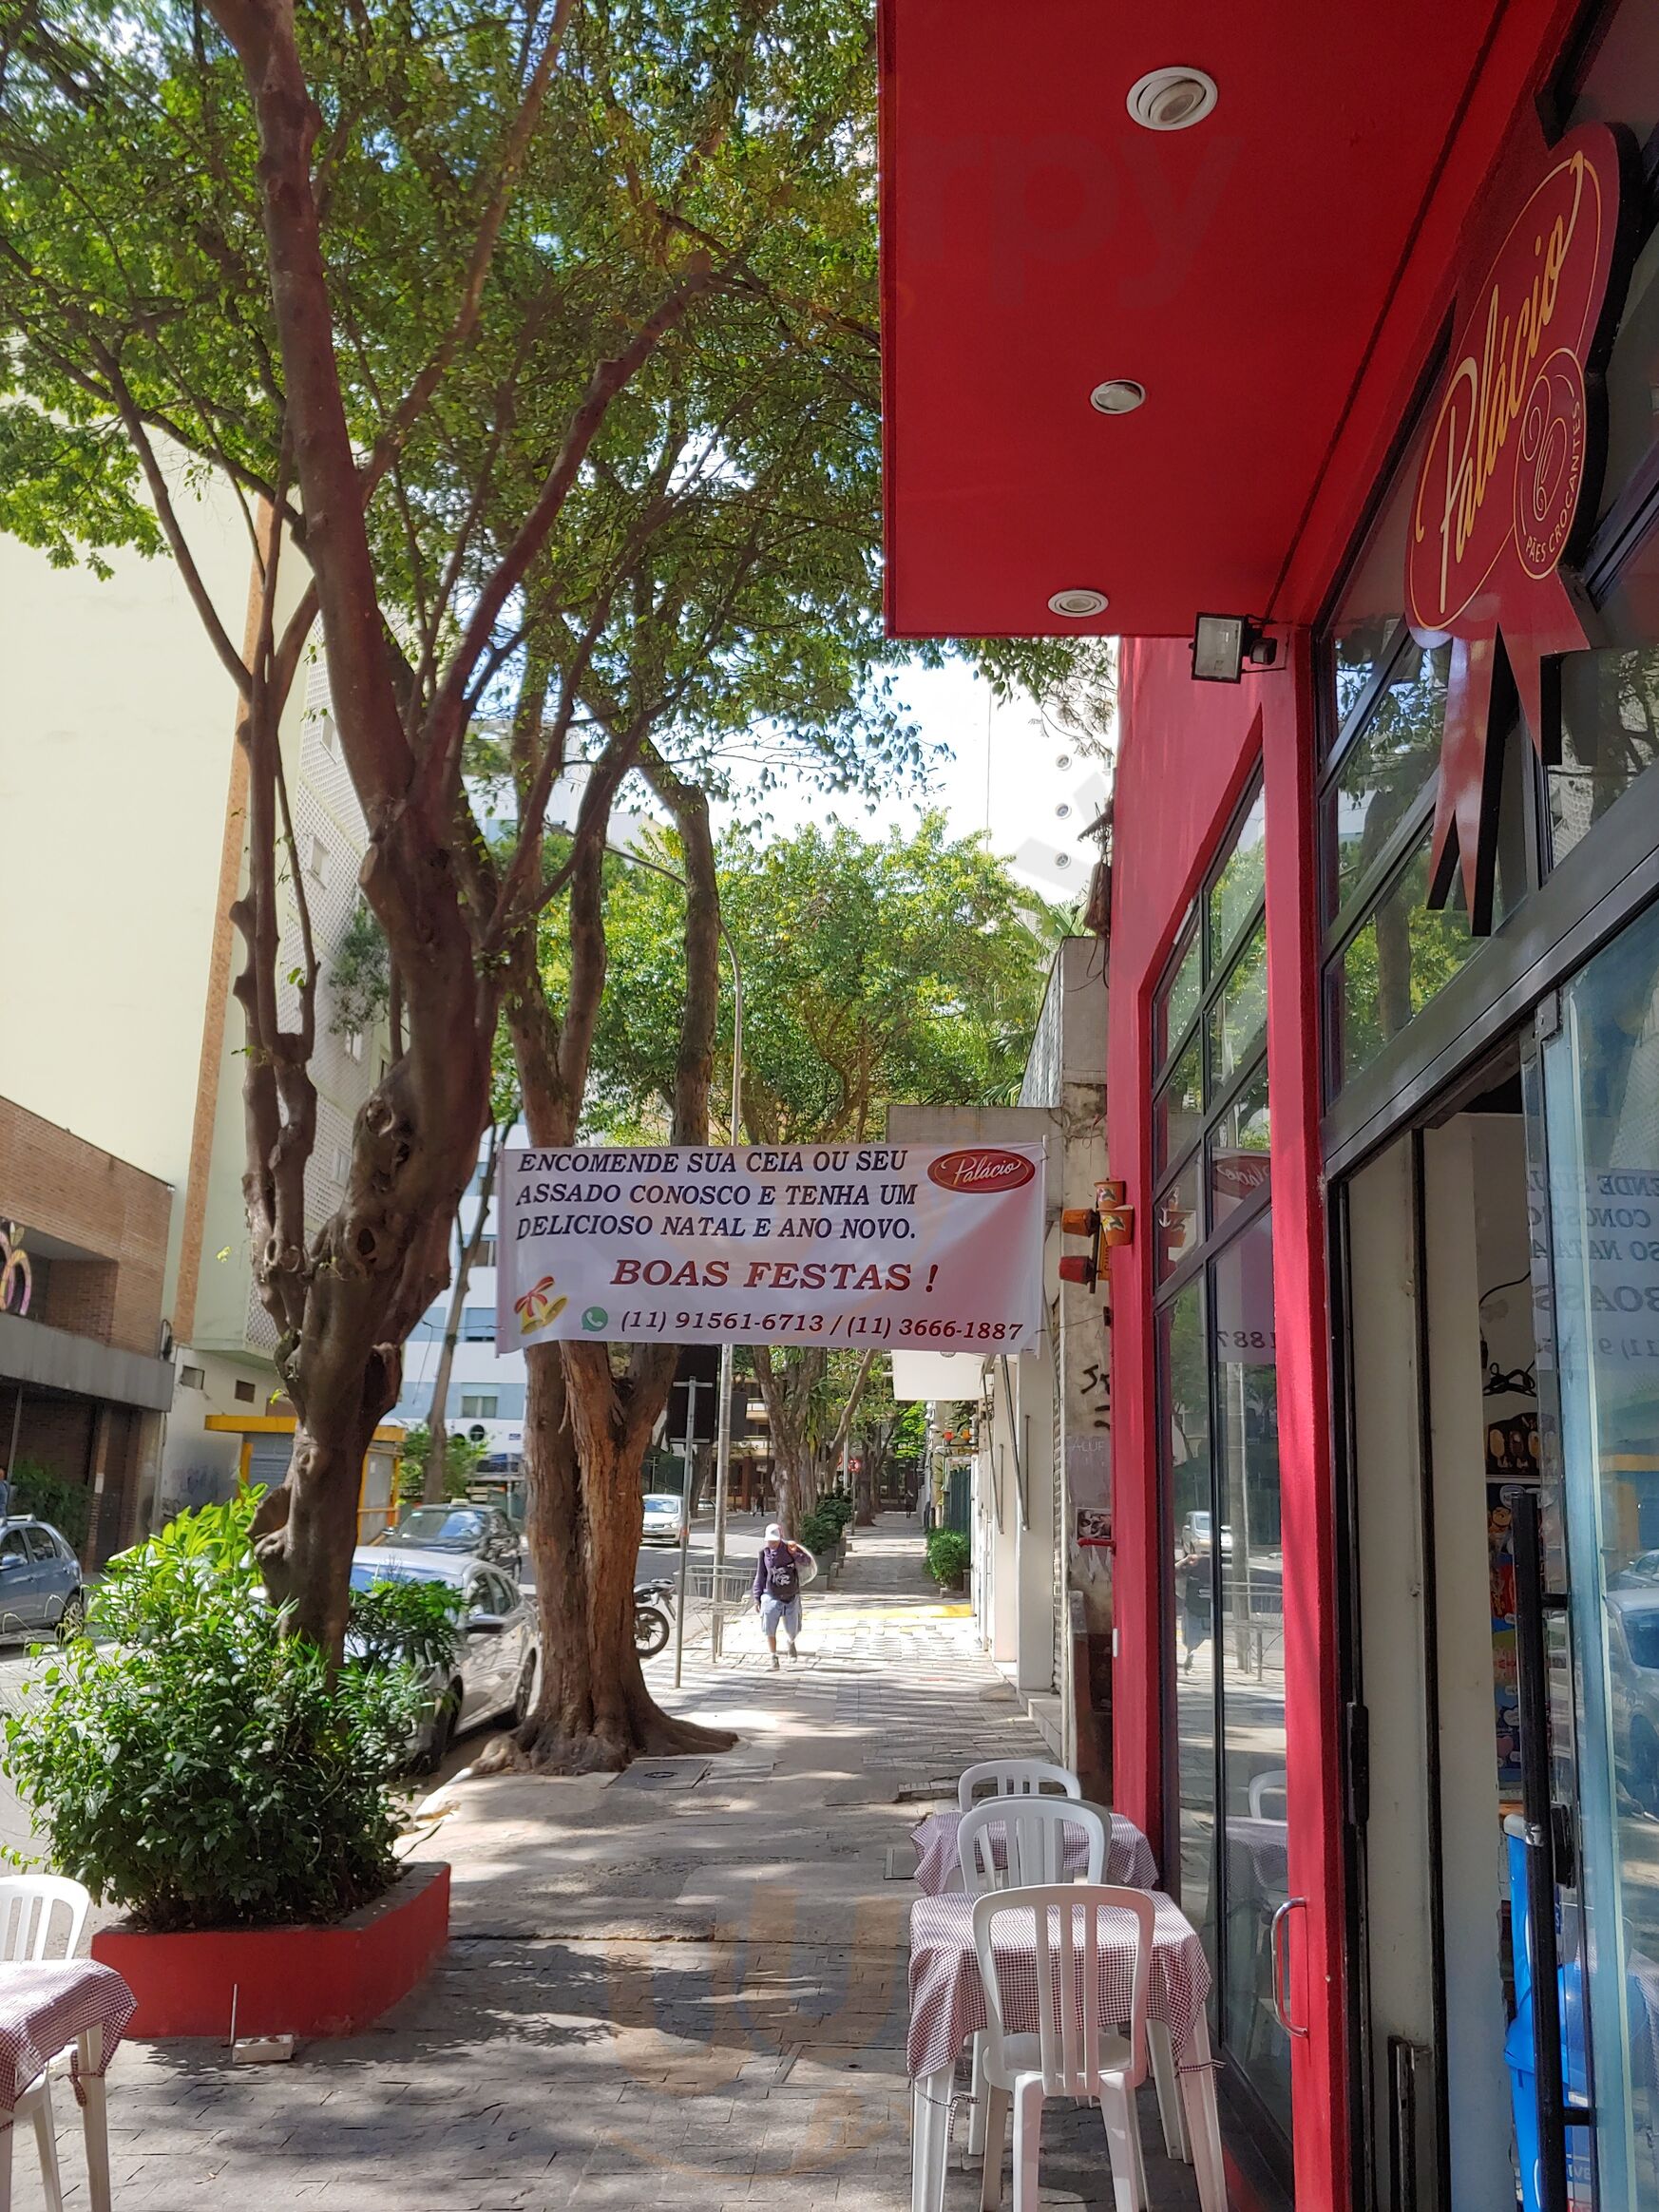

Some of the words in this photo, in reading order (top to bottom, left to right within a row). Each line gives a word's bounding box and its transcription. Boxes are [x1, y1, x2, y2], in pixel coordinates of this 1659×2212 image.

[1415, 149, 1584, 616] Palácio
[1548, 401, 1581, 553] CROCANTES
[517, 1153, 678, 1173] ENCOMENDE
[686, 1152, 736, 1173] SUA
[746, 1152, 804, 1173] CEIA
[812, 1151, 849, 1172] OU
[855, 1150, 907, 1172] SEU
[940, 1154, 1022, 1186] Palácio
[515, 1183, 620, 1206] ASSADO
[629, 1185, 752, 1205] CONOSCO
[757, 1185, 776, 1206] E
[785, 1185, 869, 1206] TENHA
[880, 1184, 918, 1205] UM
[515, 1214, 653, 1240] DELICIOSO
[660, 1216, 746, 1237] NATAL
[752, 1217, 772, 1237] E
[777, 1217, 832, 1238] ANO
[839, 1218, 916, 1239] NOVO.
[609, 1259, 730, 1287] BOAS
[743, 1261, 911, 1291] FESTAS
[925, 1264, 939, 1292] !
[620, 1310, 667, 1332] (11)
[675, 1311, 824, 1331] 91561-6713
[848, 1316, 891, 1340] (11)
[899, 1318, 1024, 1341] 3666-1887
